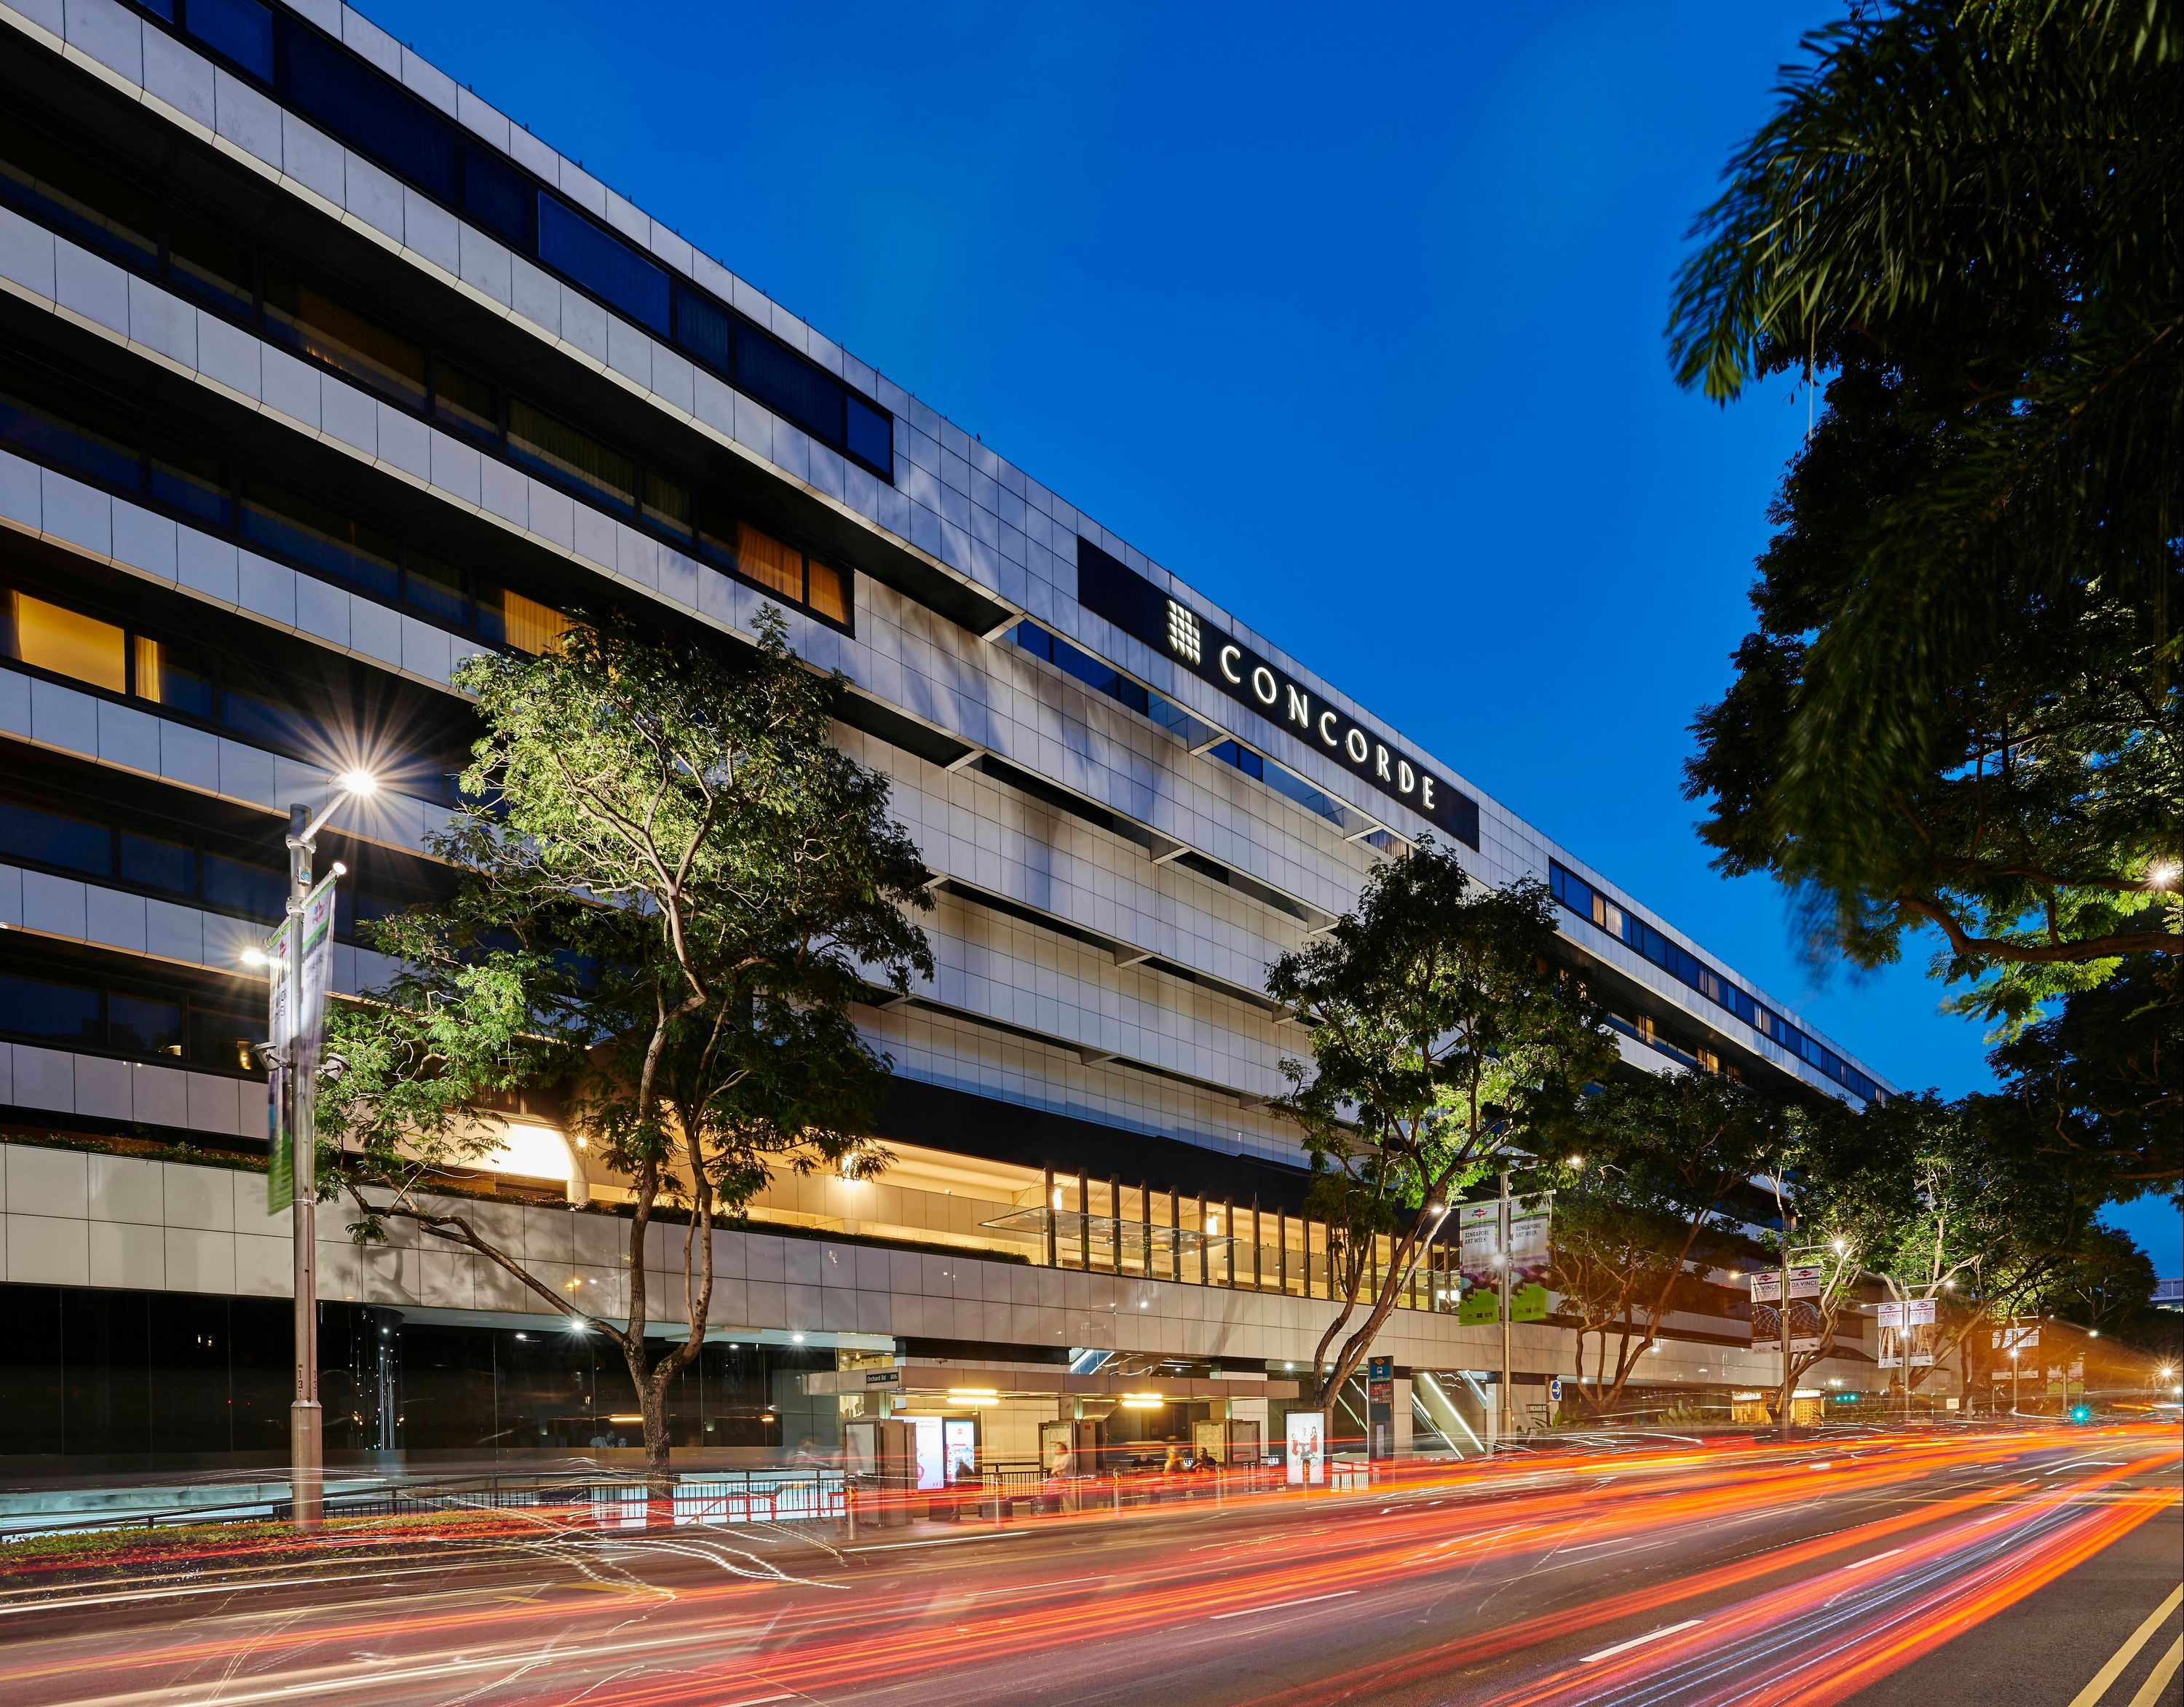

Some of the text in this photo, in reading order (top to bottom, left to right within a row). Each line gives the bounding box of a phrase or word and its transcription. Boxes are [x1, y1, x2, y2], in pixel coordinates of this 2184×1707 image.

[1219, 645, 1435, 809] CONCORDE
[1516, 1222, 1542, 1232] SINGAPORE
[1465, 1229, 1489, 1238] SINGAPORE
